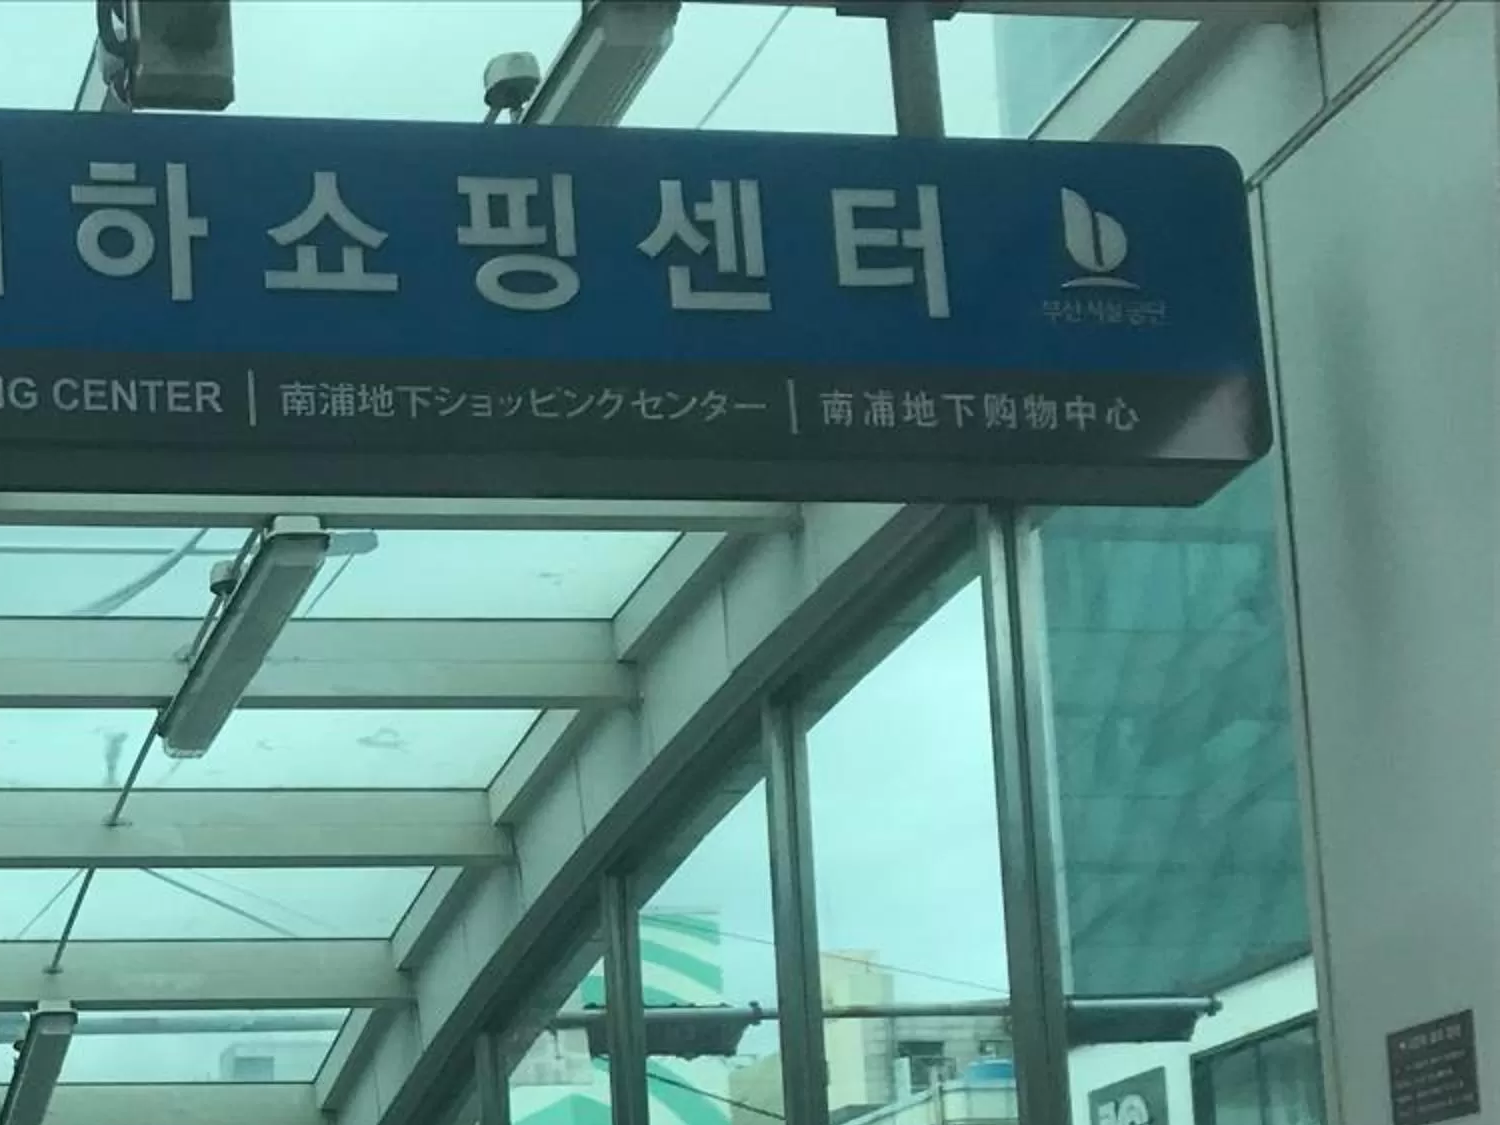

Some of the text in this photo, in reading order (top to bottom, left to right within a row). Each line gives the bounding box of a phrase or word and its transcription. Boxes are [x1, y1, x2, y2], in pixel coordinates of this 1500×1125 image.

[51, 377, 225, 415] CENTER
[279, 381, 768, 427] 南浦地下ショッピングセンター
[819, 388, 1141, 433] 南浦地下购物中心
